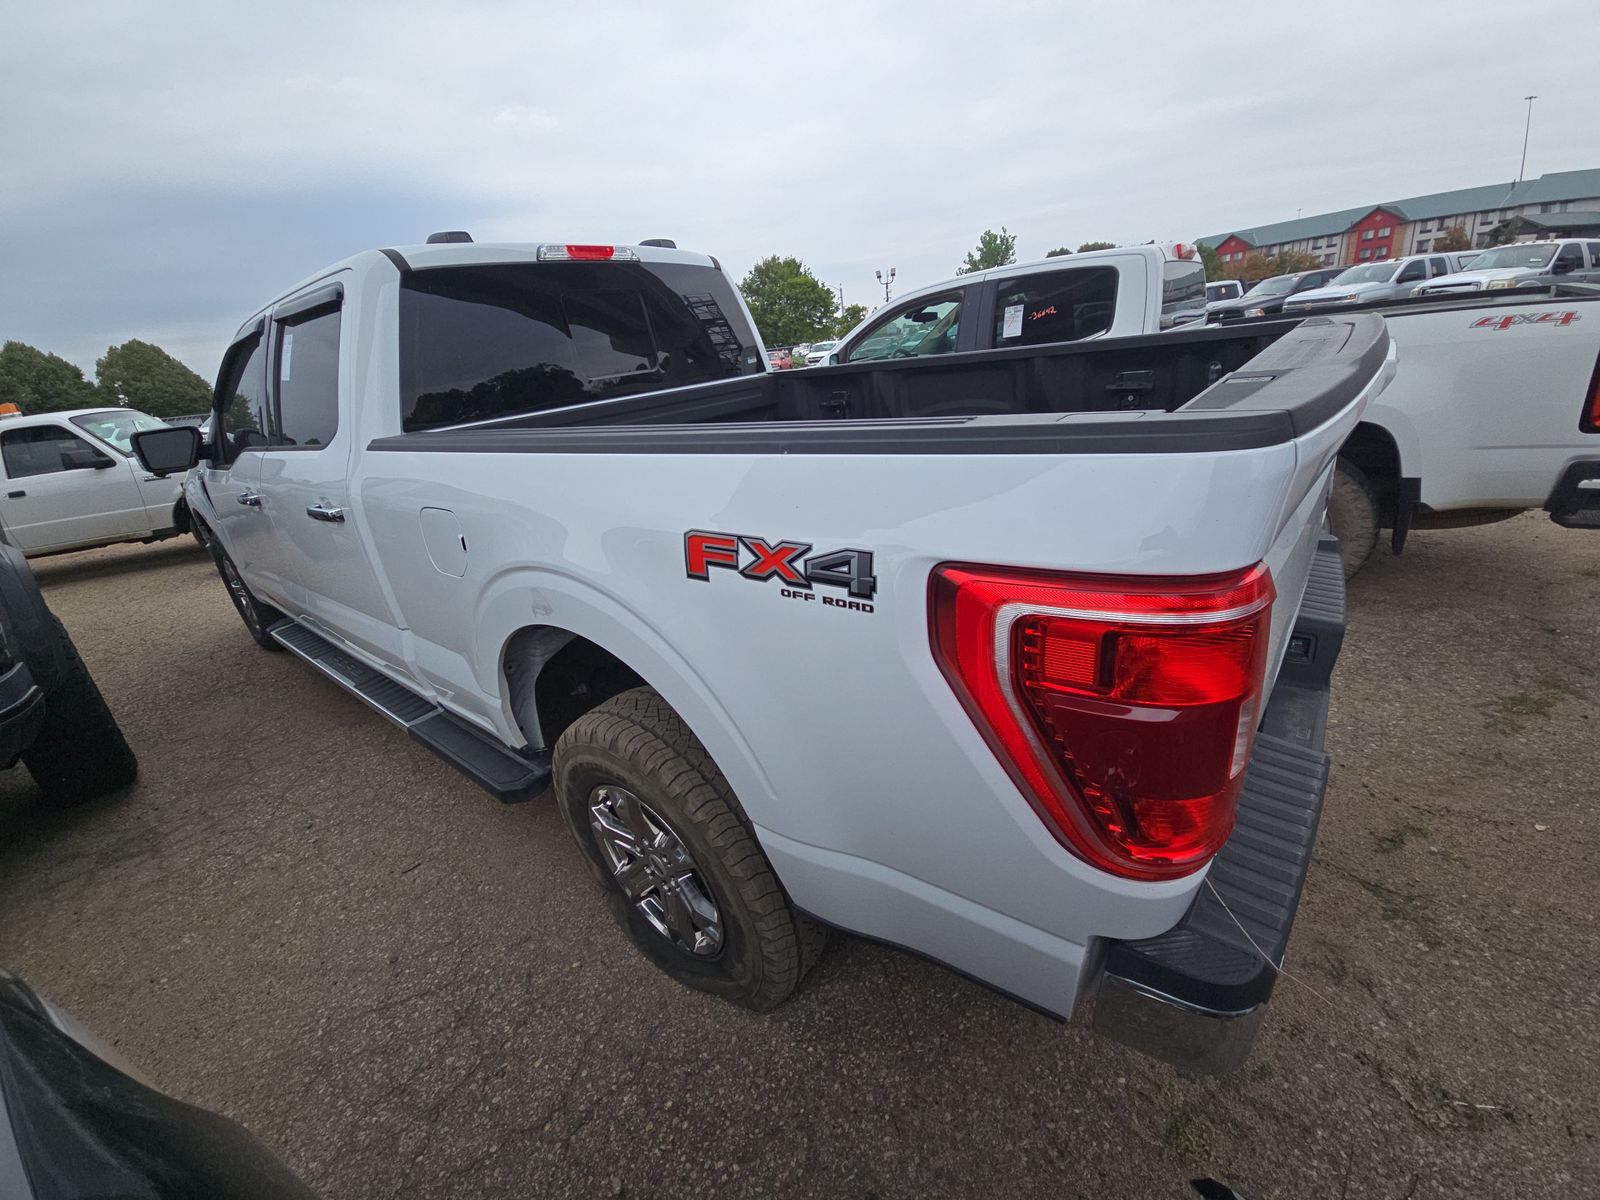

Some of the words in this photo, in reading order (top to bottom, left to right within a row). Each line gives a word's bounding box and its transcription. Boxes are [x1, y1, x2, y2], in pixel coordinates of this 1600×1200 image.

[683, 528, 878, 602] FX4
[780, 588, 816, 602] OFF
[822, 595, 875, 614] ROAD
